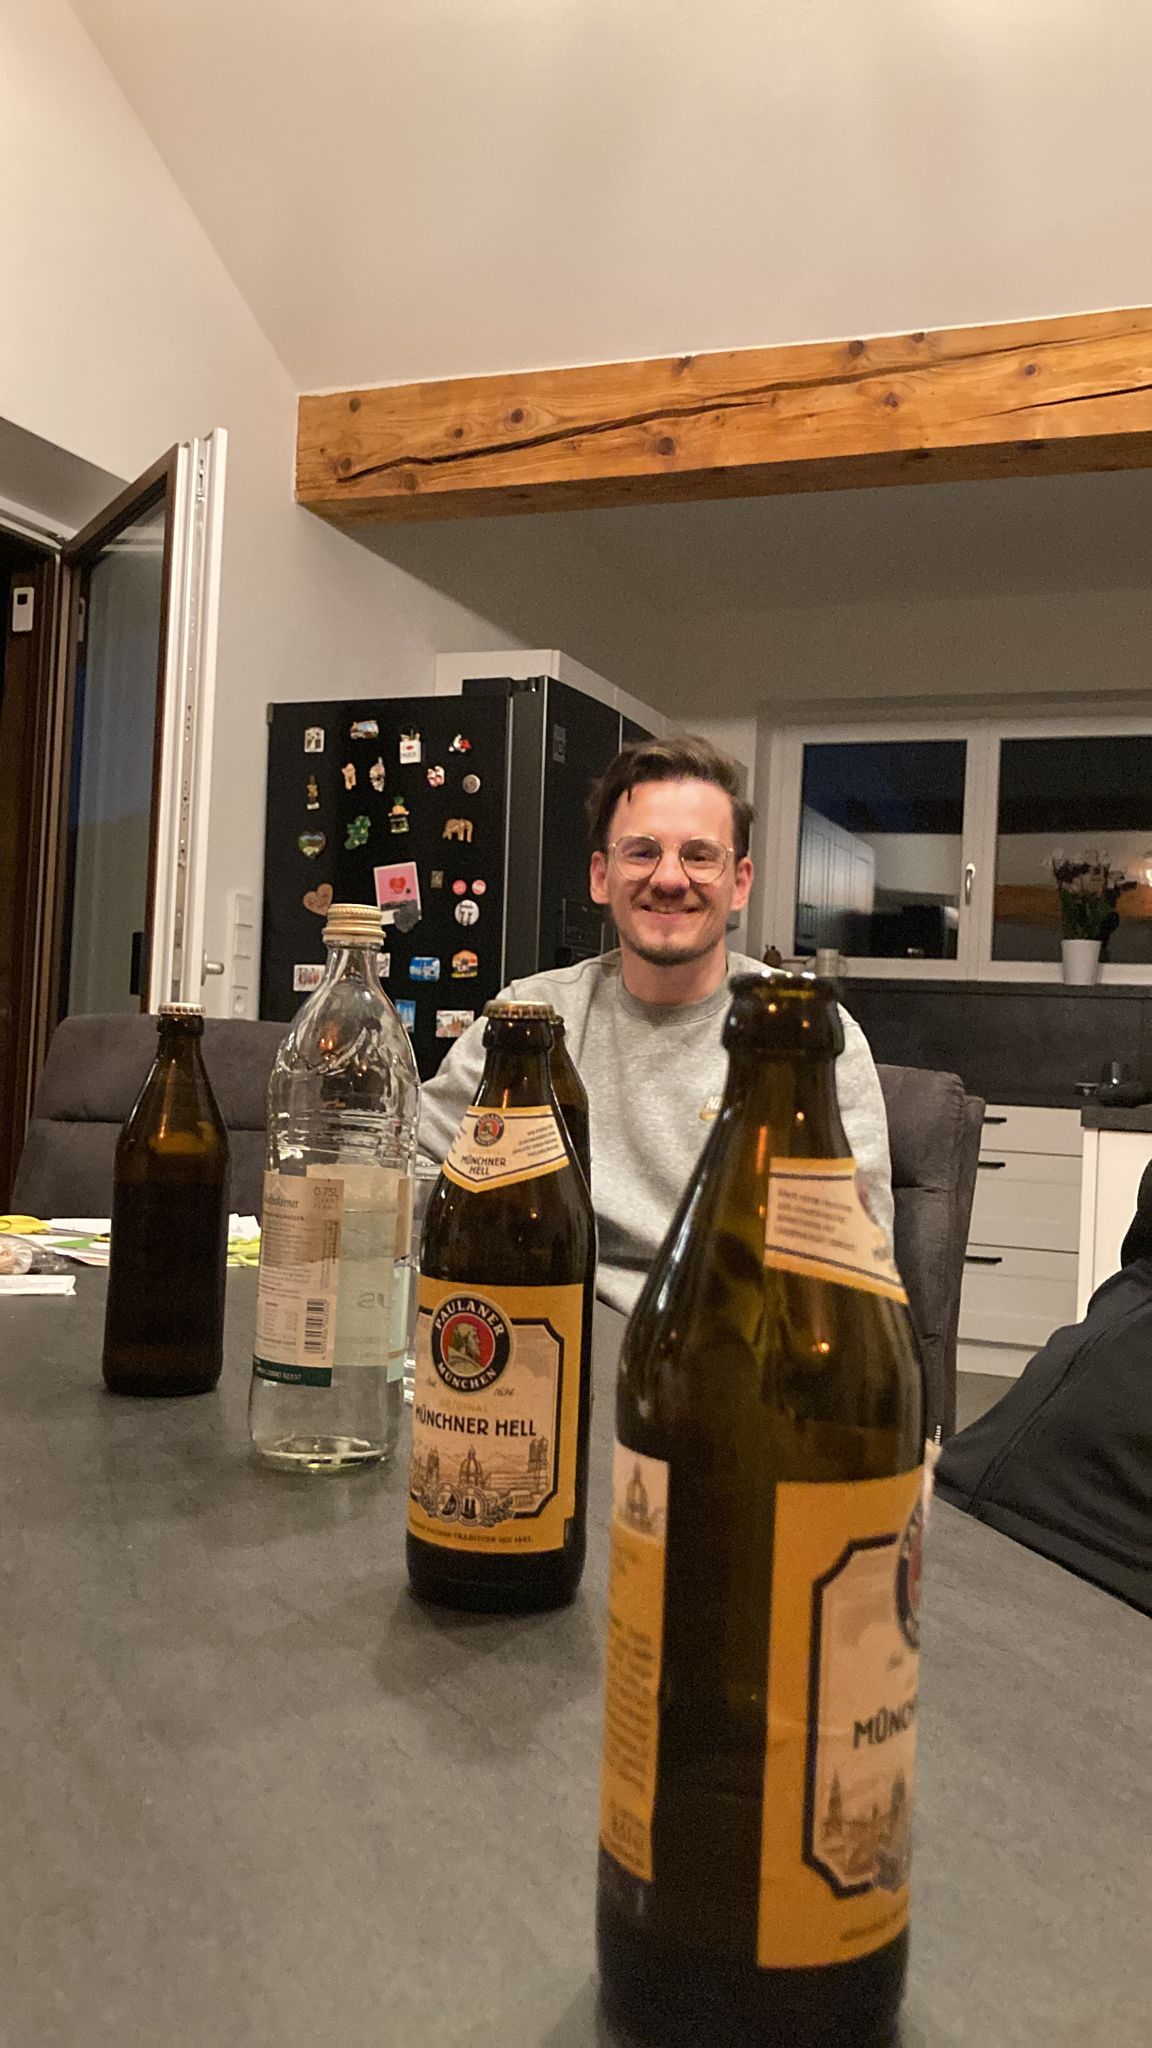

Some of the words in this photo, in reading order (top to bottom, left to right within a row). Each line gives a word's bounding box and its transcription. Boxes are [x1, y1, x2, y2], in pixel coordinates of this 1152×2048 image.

[469, 1166, 490, 1175] HELL
[434, 1300, 505, 1337] PAULANER
[415, 1403, 489, 1436] MÜNCHNER
[495, 1419, 537, 1437] HELL
